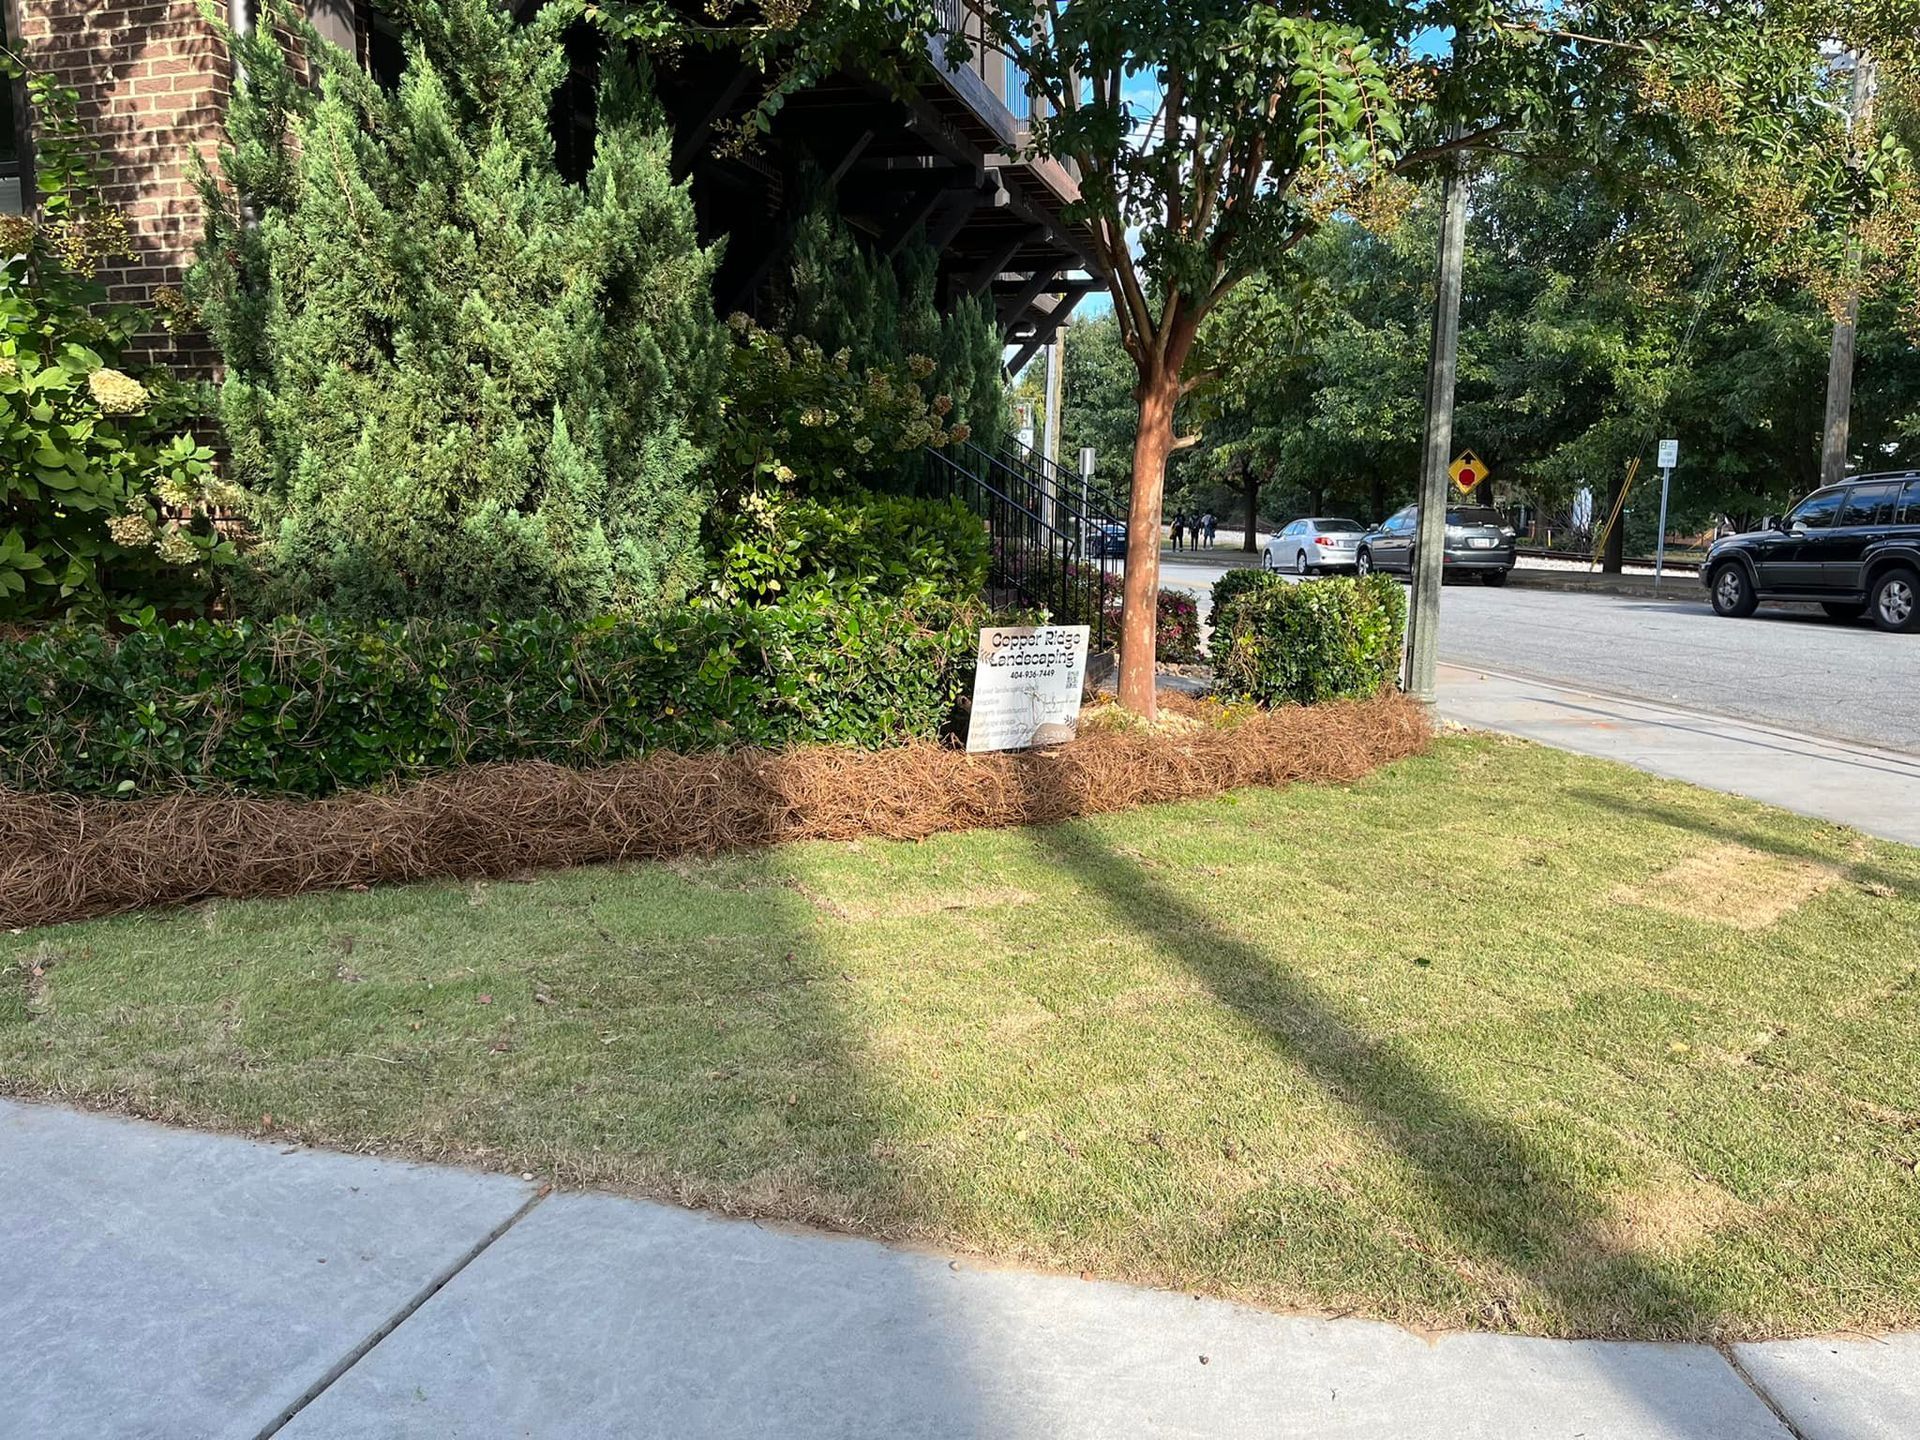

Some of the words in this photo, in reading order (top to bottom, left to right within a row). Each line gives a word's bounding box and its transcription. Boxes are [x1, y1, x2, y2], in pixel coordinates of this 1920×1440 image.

[992, 632, 1042, 650] Copper
[1044, 630, 1081, 650] Ridge
[990, 649, 1075, 668] Landscaping
[1010, 669, 1055, 680] 404-936-7449
